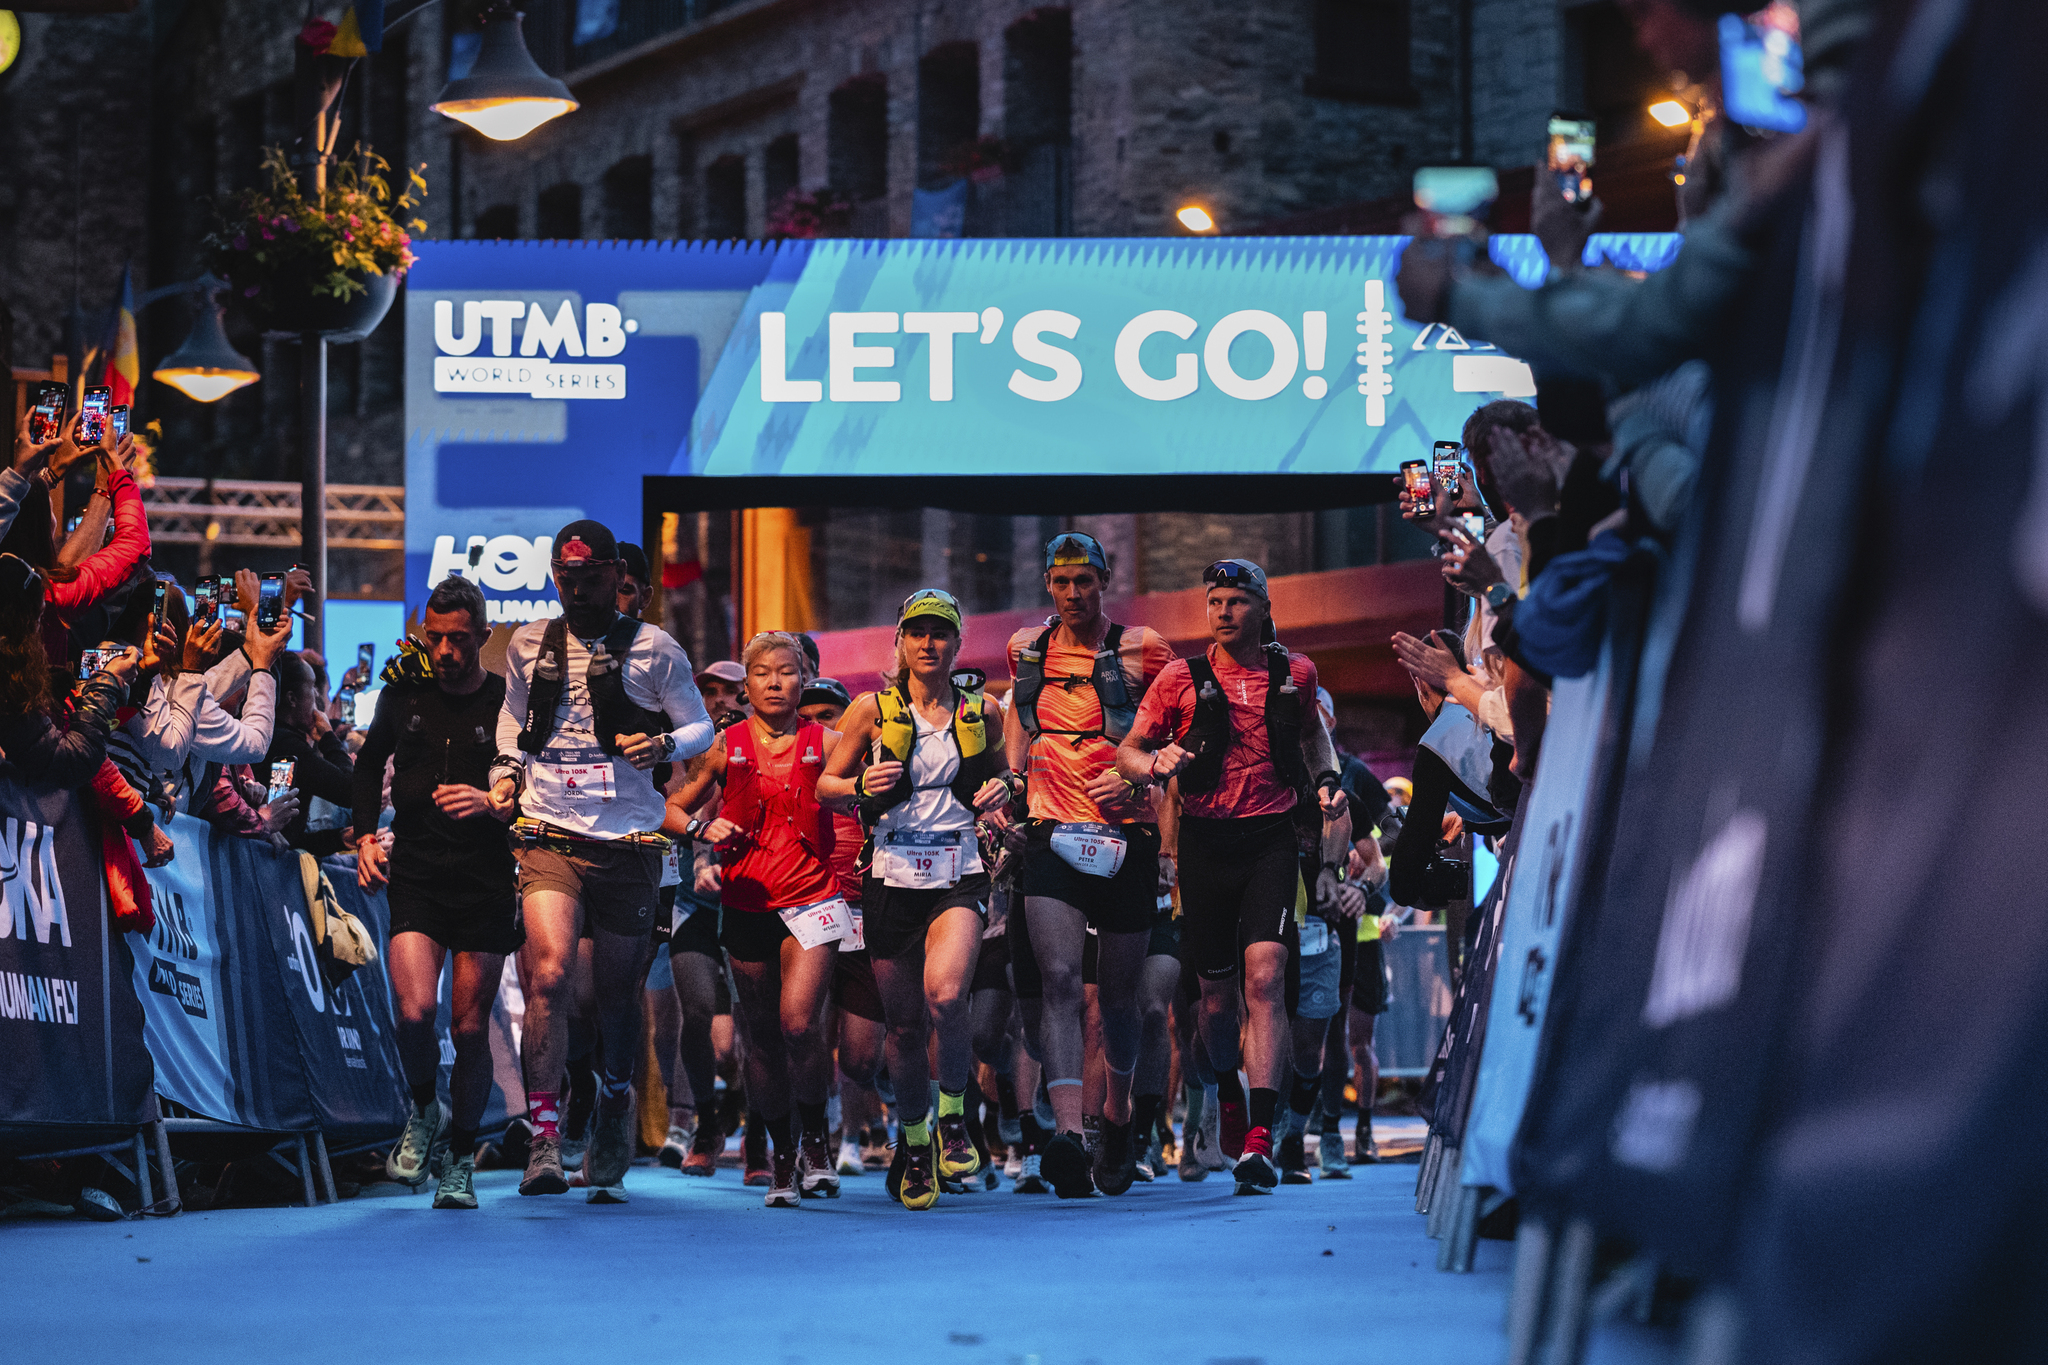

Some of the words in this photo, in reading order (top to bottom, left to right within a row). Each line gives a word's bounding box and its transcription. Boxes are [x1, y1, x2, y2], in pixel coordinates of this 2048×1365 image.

[435, 301, 625, 357] UTMB
[761, 307, 1082, 402] LET'S
[1115, 310, 1327, 401] GO!
[447, 367, 531, 383] WORLD
[546, 373, 615, 389] SERIES
[566, 777, 577, 789] 6
[1081, 844, 1097, 857] 10
[915, 858, 933, 871] 19
[818, 913, 834, 926] 21
[51, 977, 78, 1025] FLY
